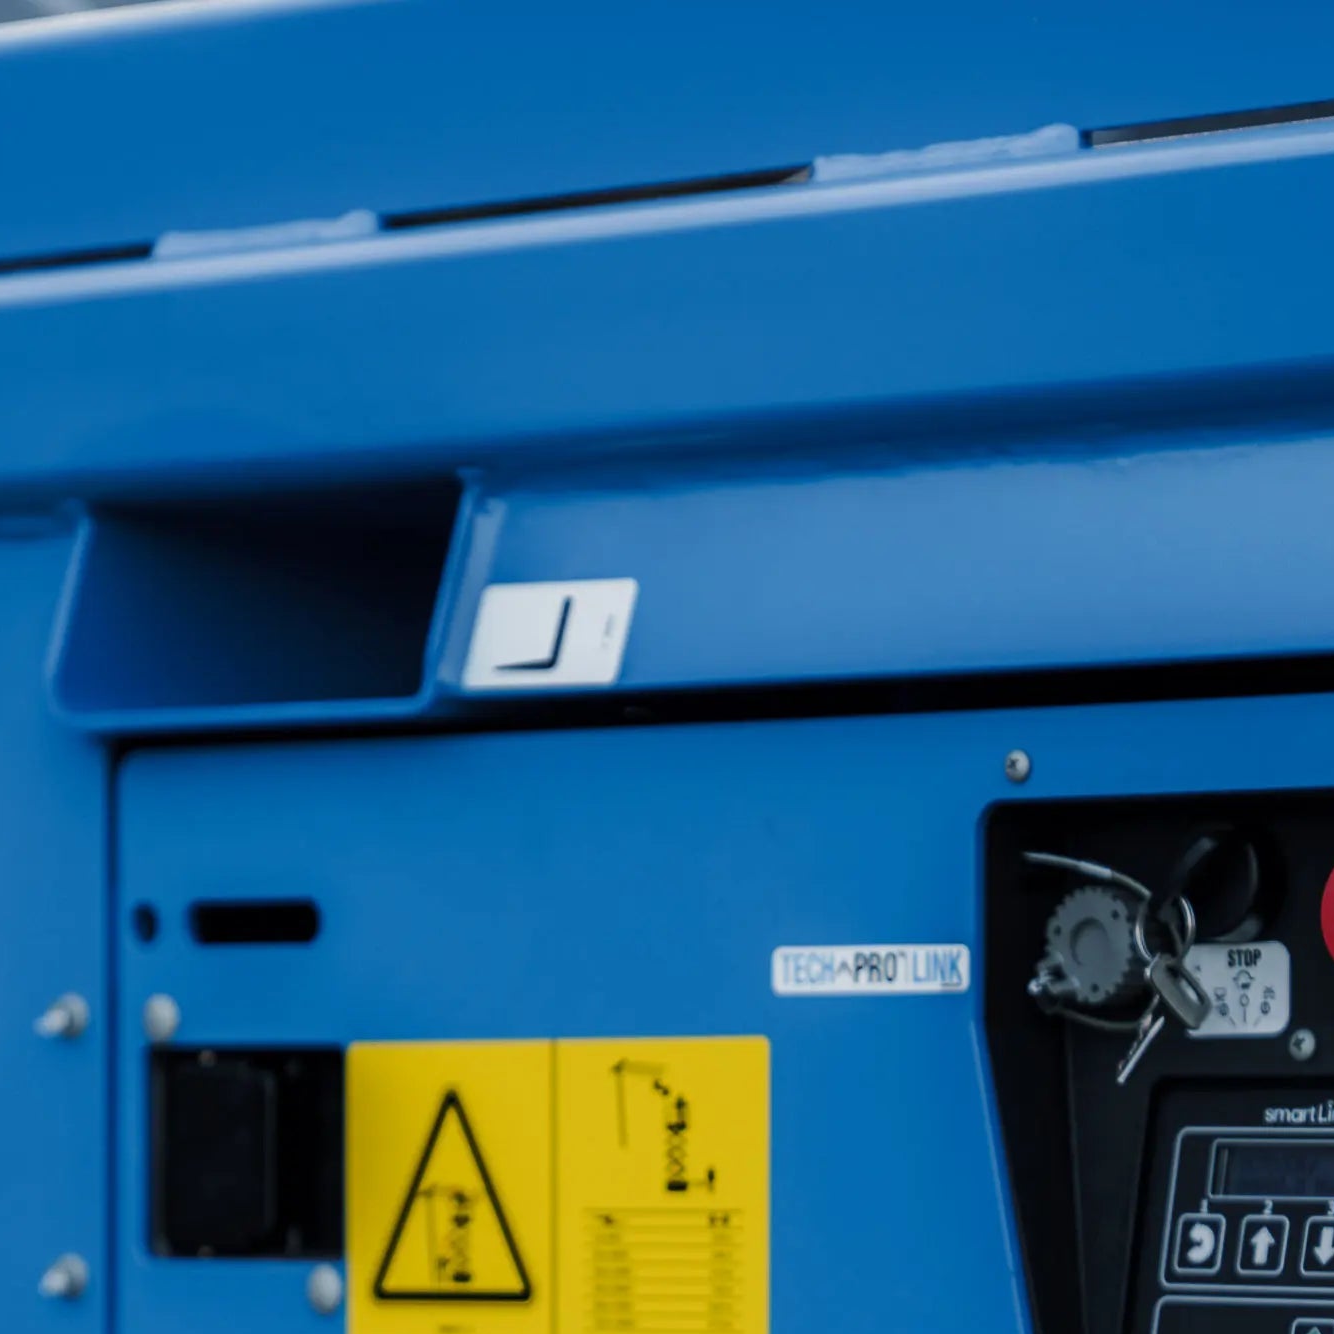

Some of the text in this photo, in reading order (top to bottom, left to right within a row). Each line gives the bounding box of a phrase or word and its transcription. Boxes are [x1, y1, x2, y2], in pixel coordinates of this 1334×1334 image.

[913, 950, 963, 984] LINK
[1228, 949, 1262, 968] STOP
[1264, 1198, 1273, 1215] 2
